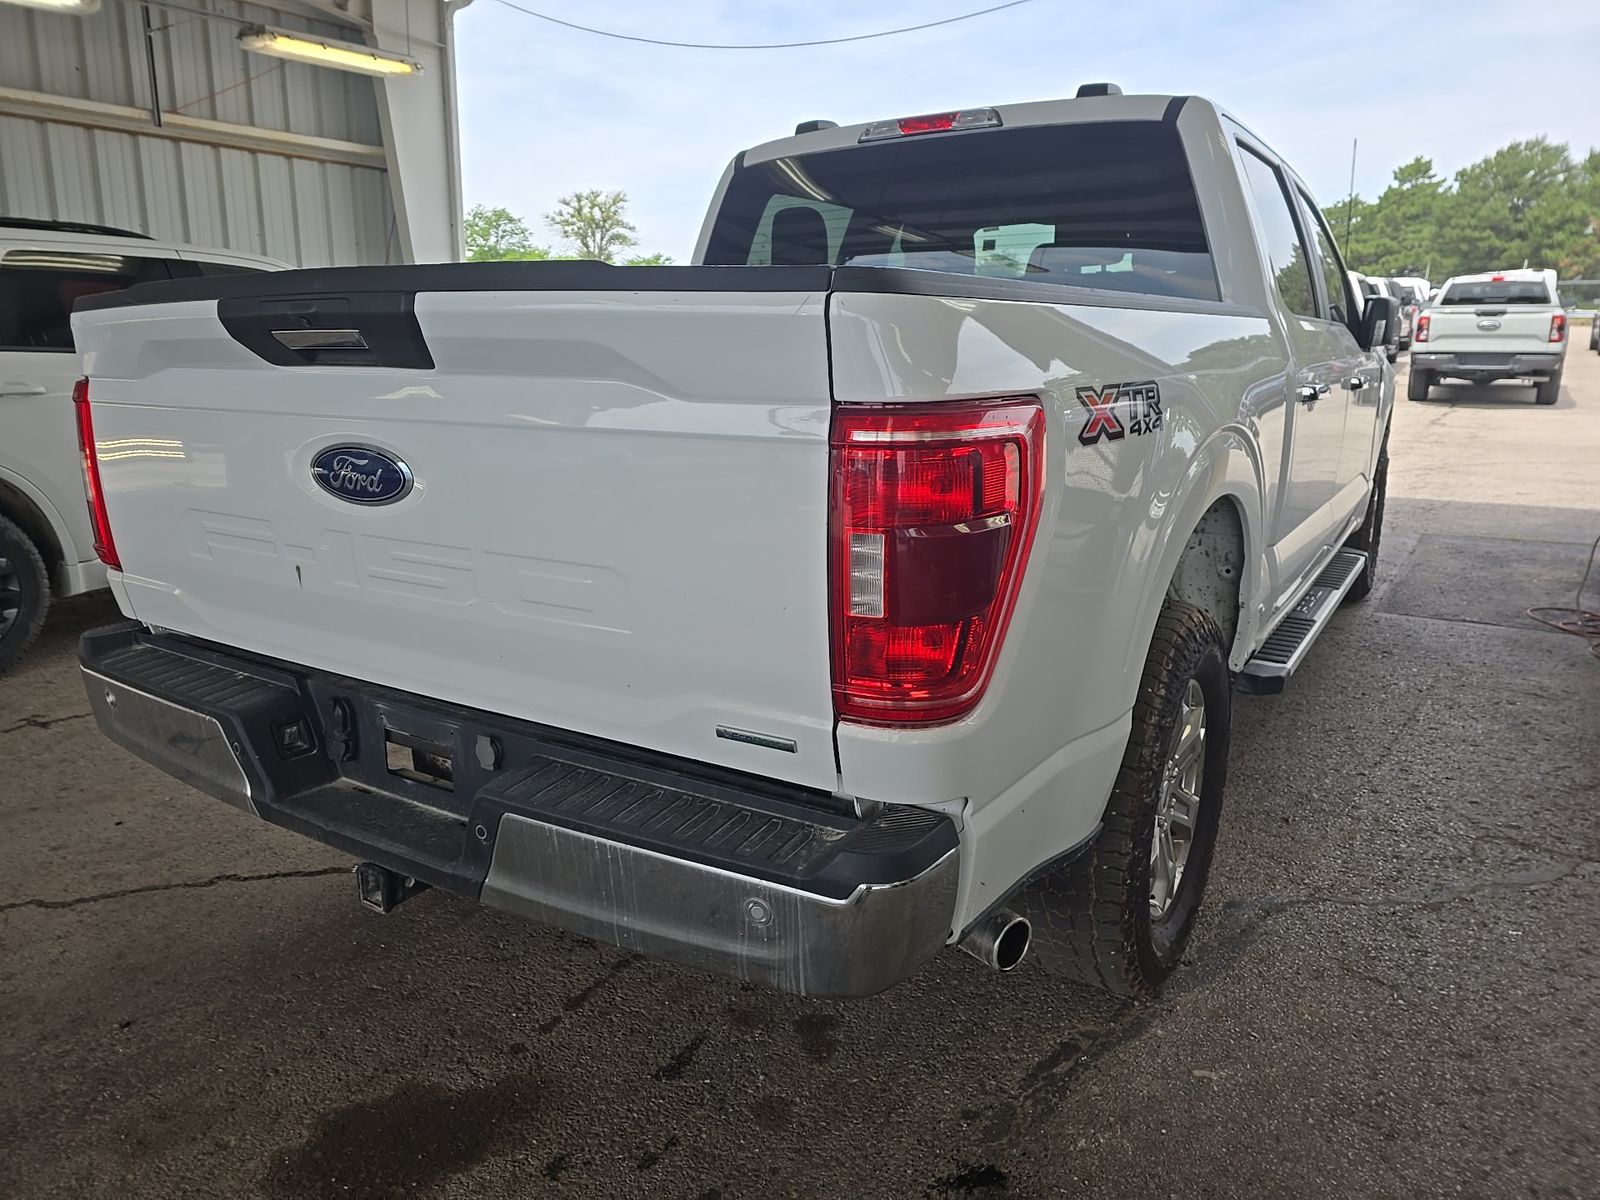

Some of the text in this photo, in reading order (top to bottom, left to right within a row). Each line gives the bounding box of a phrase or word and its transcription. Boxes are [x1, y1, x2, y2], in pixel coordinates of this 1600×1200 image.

[1075, 380, 1163, 446] XTR
[329, 455, 383, 493] Ford
[185, 506, 633, 634] F-150
